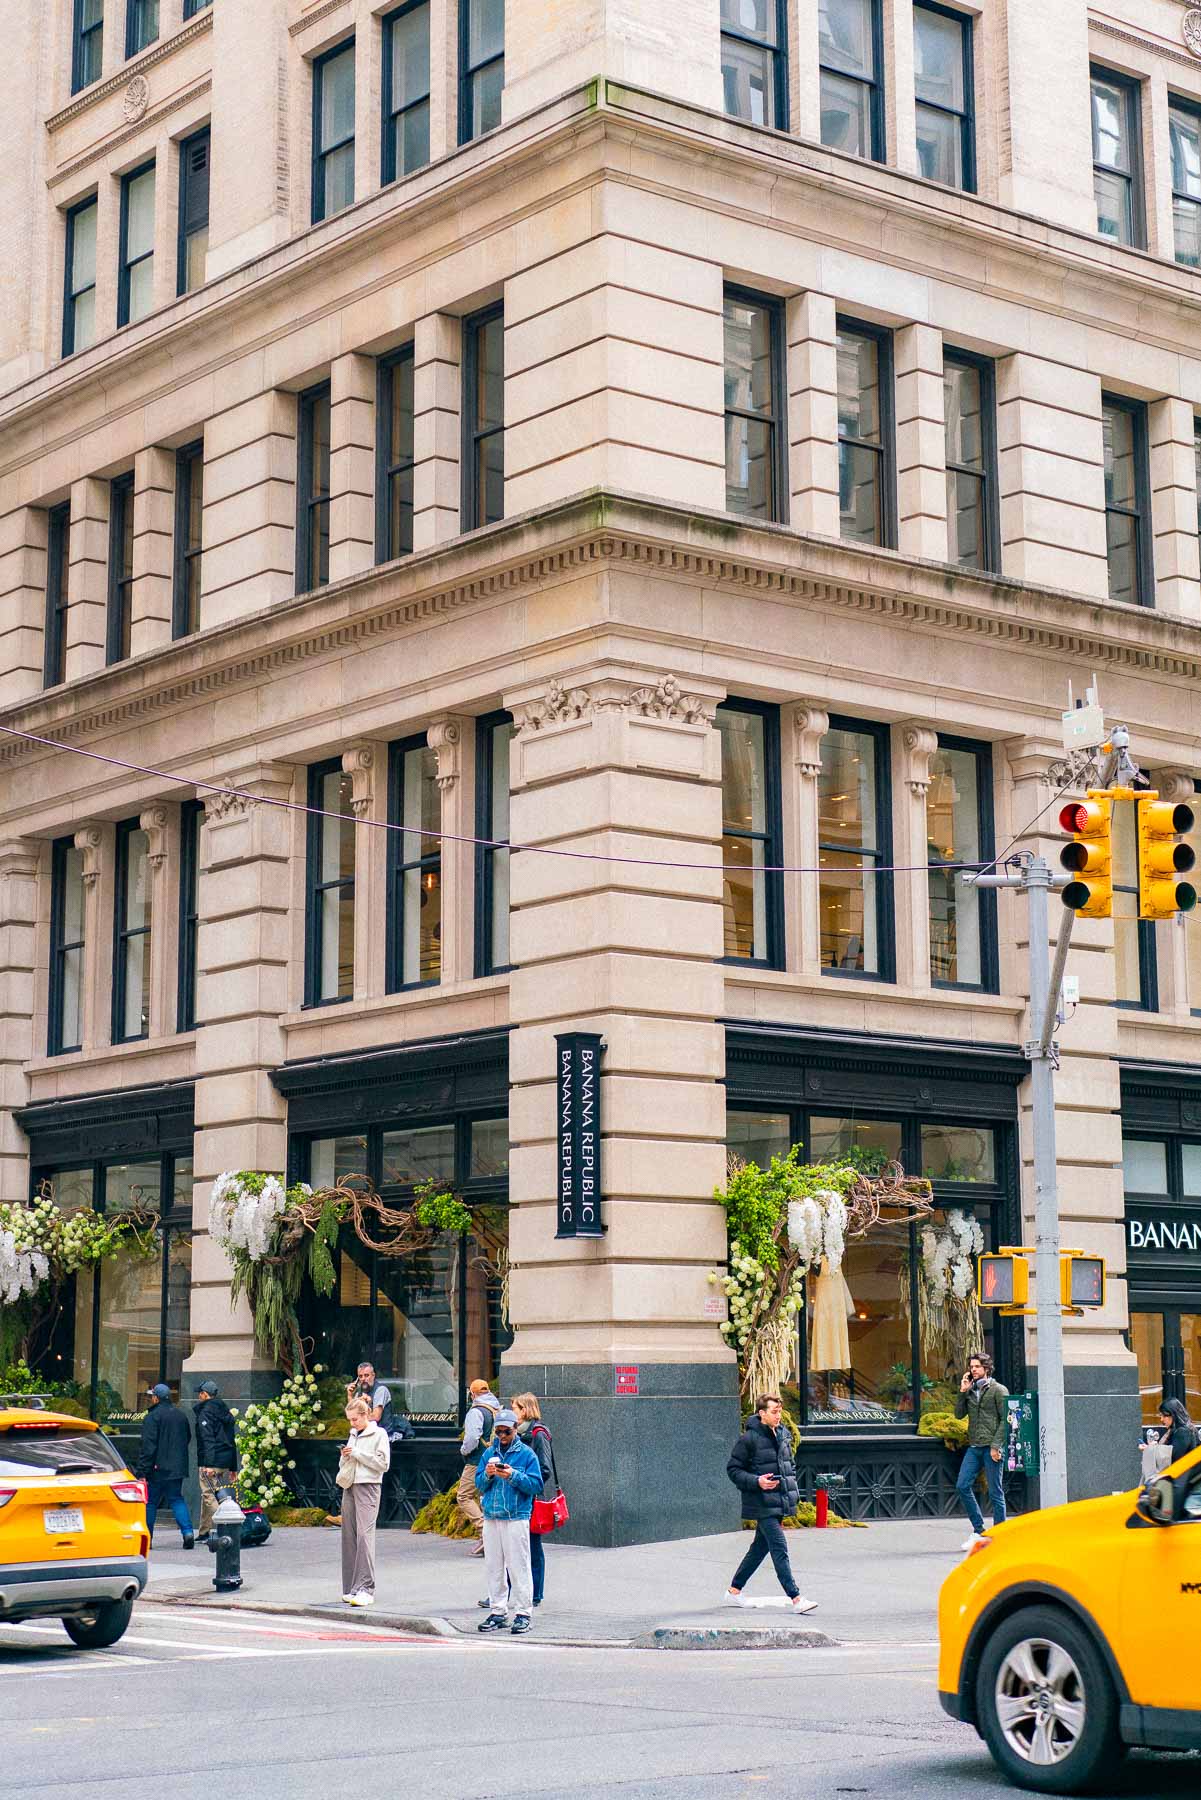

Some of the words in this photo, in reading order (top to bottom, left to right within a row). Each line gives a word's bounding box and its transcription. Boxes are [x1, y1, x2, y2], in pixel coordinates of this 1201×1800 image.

[561, 1050, 572, 1128] BANANA
[581, 1049, 594, 1128] BANANA
[562, 1132, 573, 1223] REPUBLIC
[582, 1132, 595, 1222] REPUBLIC
[420, 1413, 458, 1422] REPUBLIC
[813, 1411, 853, 1420] BANANA
[852, 1411, 897, 1420] REPUBLIC
